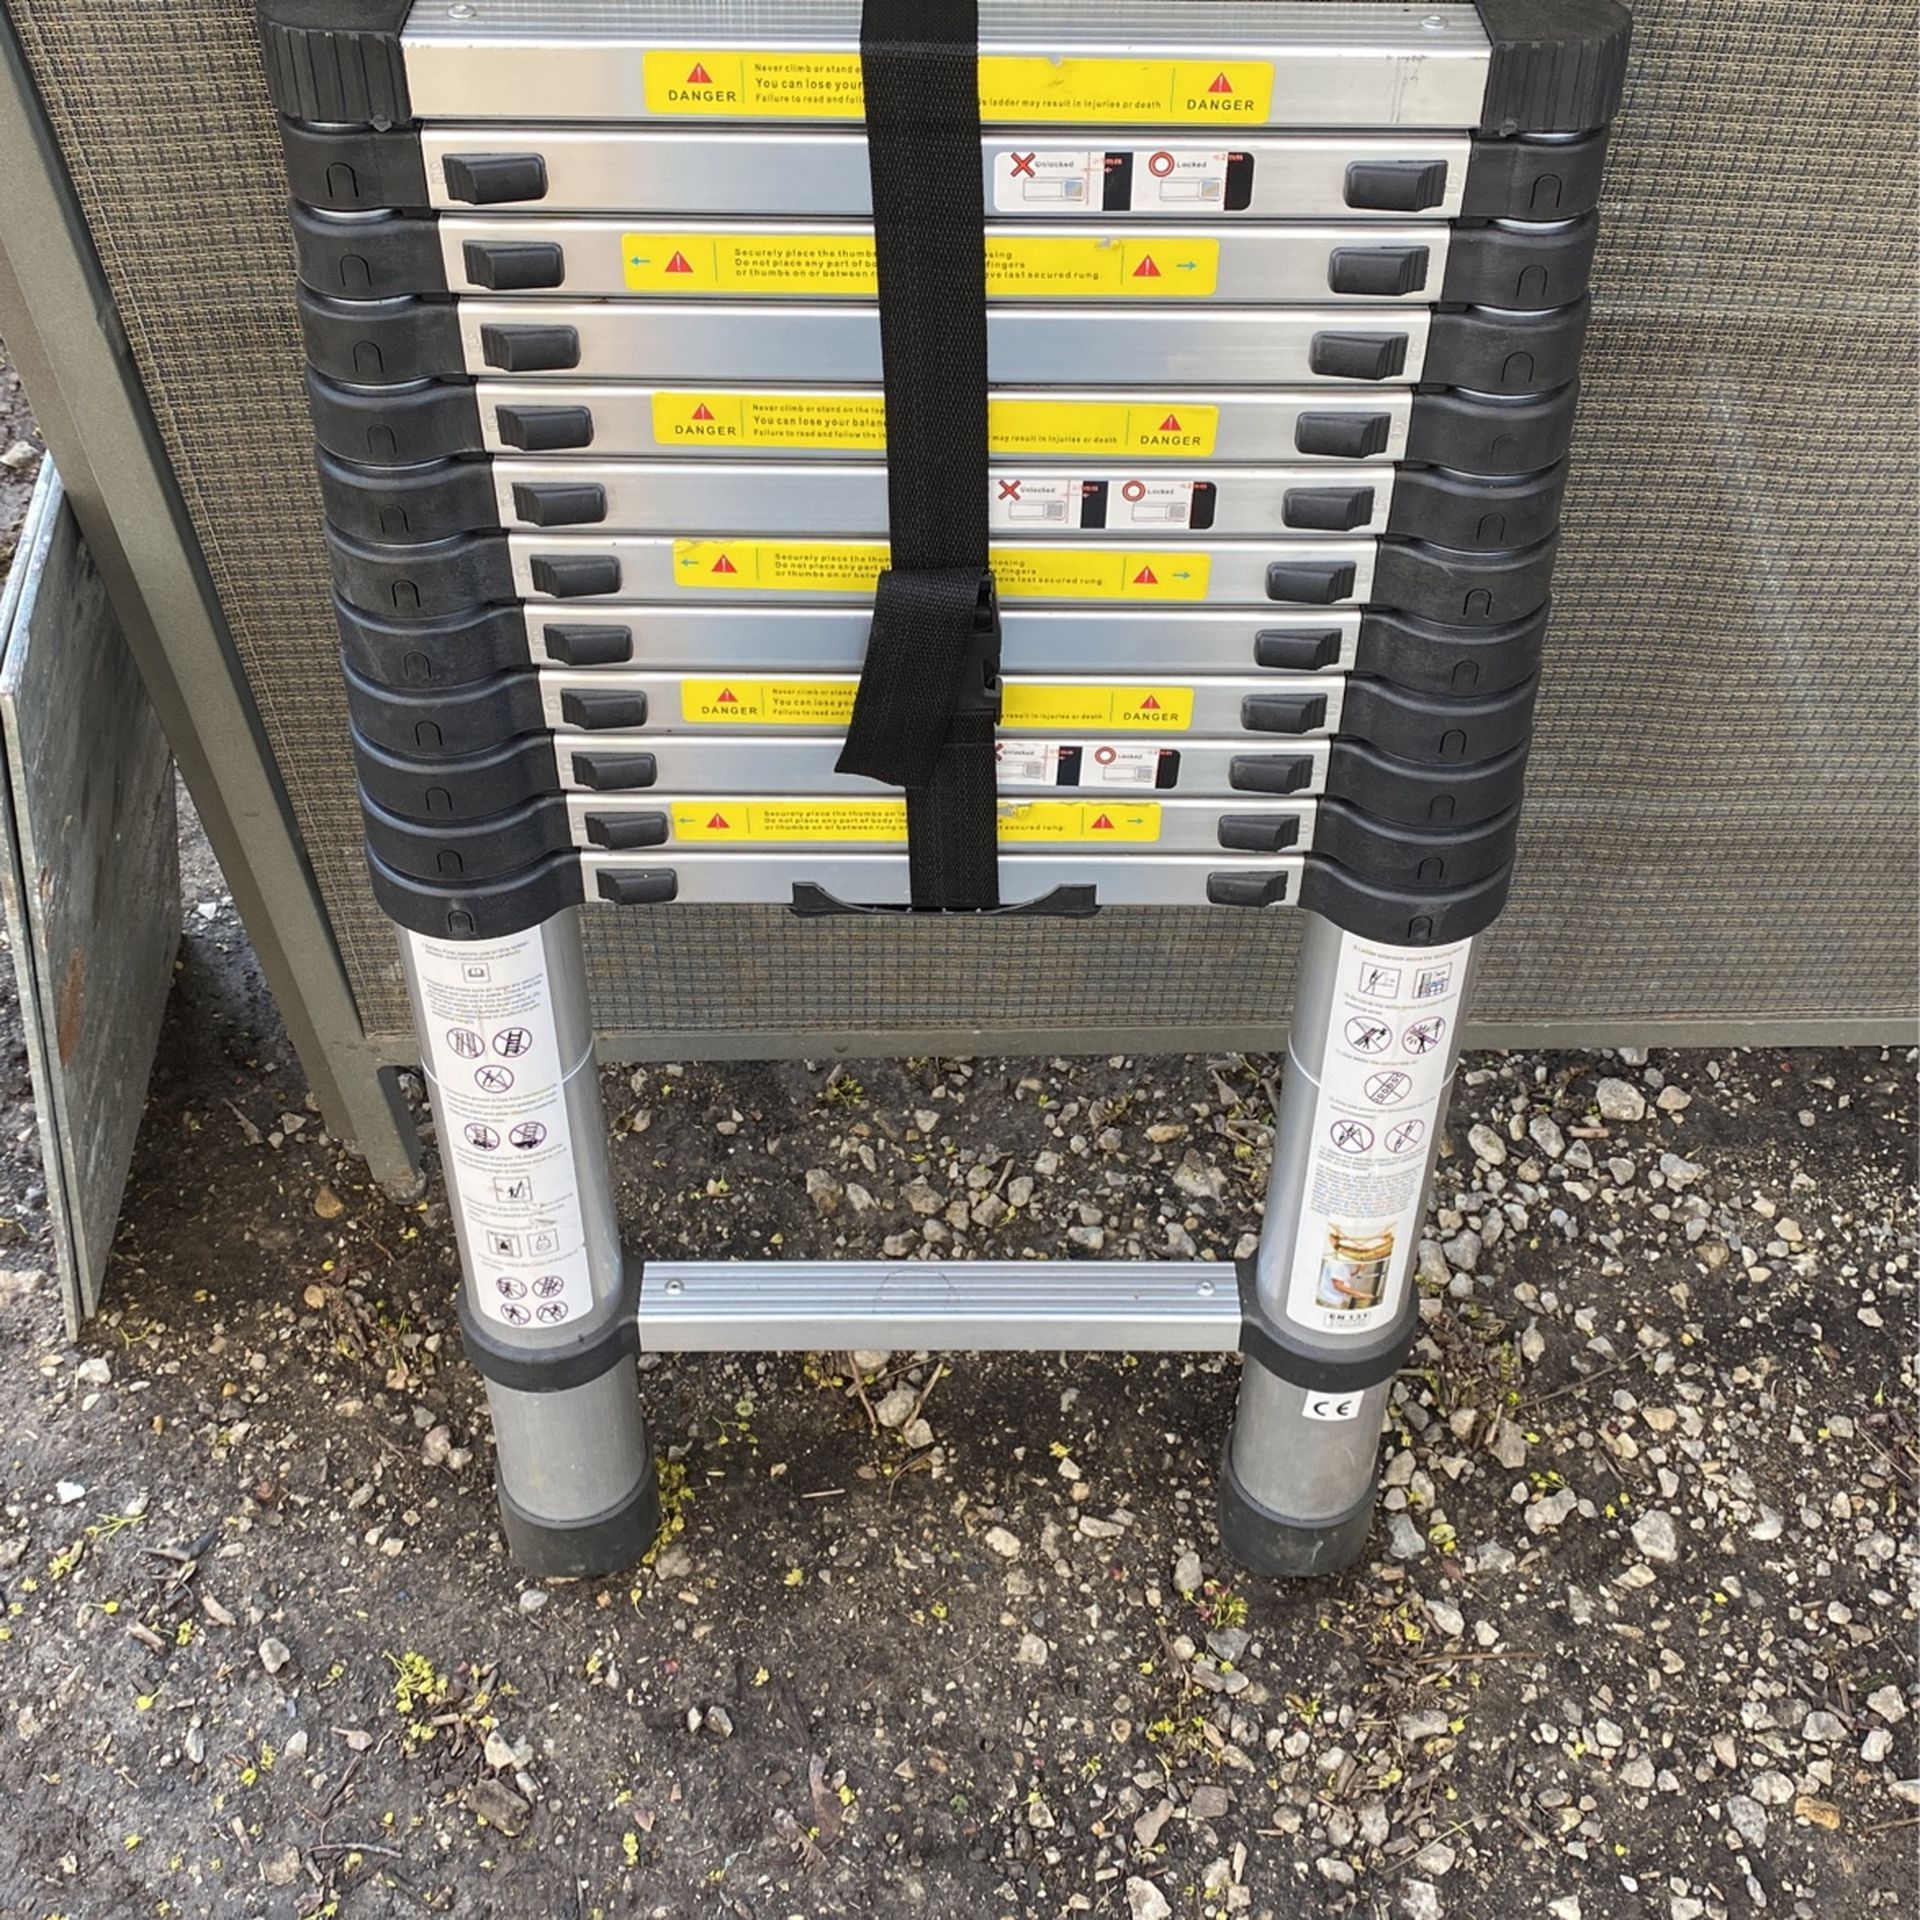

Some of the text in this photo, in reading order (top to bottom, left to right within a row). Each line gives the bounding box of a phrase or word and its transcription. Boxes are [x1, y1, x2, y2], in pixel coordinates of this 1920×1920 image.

[754, 63, 783, 72] Never
[784, 64, 811, 73] climb
[813, 66, 823, 74] or
[826, 64, 853, 73] stand
[756, 78, 864, 92] You can lose your
[668, 90, 737, 103] DANGER
[756, 94, 866, 105] Failure to read and foll
[989, 98, 1020, 107] ladder
[1021, 101, 1041, 110] may
[1042, 99, 1072, 108] result
[1083, 99, 1121, 110] injuries
[1136, 100, 1162, 109] death
[1186, 98, 1256, 112] DANGER
[1035, 160, 1075, 169] Unlocked
[1176, 160, 1208, 169] Locked
[734, 248, 782, 258] Securely
[785, 248, 815, 259] place
[818, 248, 835, 257] the
[734, 257, 750, 267] Do
[753, 258, 770, 267] not
[772, 258, 802, 269] place
[805, 260, 824, 269] any
[826, 259, 849, 269] part
[851, 259, 863, 268] of
[987, 261, 1026, 270] fingers
[749, 268, 790, 277] thumbs
[823, 269, 868, 278] between
[1004, 270, 1026, 279] last
[1027, 271, 1072, 280] secured
[752, 403, 779, 412] Never
[779, 404, 804, 413] climb
[817, 405, 842, 414] stand
[855, 406, 868, 414] the
[753, 415, 774, 425] You
[776, 417, 797, 426] can
[799, 416, 823, 426] lose
[824, 418, 850, 428] your
[674, 425, 737, 437] DANGER
[753, 429, 787, 437] Failure
[788, 429, 798, 437] to
[817, 430, 833, 438] and
[834, 430, 861, 439] follow
[862, 431, 877, 439] the
[992, 434, 1010, 444] may
[1093, 435, 1118, 444] death
[1139, 434, 1202, 447] DANGER
[774, 553, 820, 563] Securely
[821, 554, 845, 563] place
[846, 554, 866, 563] the
[857, 563, 878, 571] part
[785, 570, 825, 578] thumbs
[854, 570, 878, 578] betw
[1038, 576, 1079, 585] secured
[773, 698, 793, 707] You
[701, 706, 759, 716] DANGER
[1122, 711, 1180, 722] DANGER
[1313, 1400, 1352, 1417] CE
